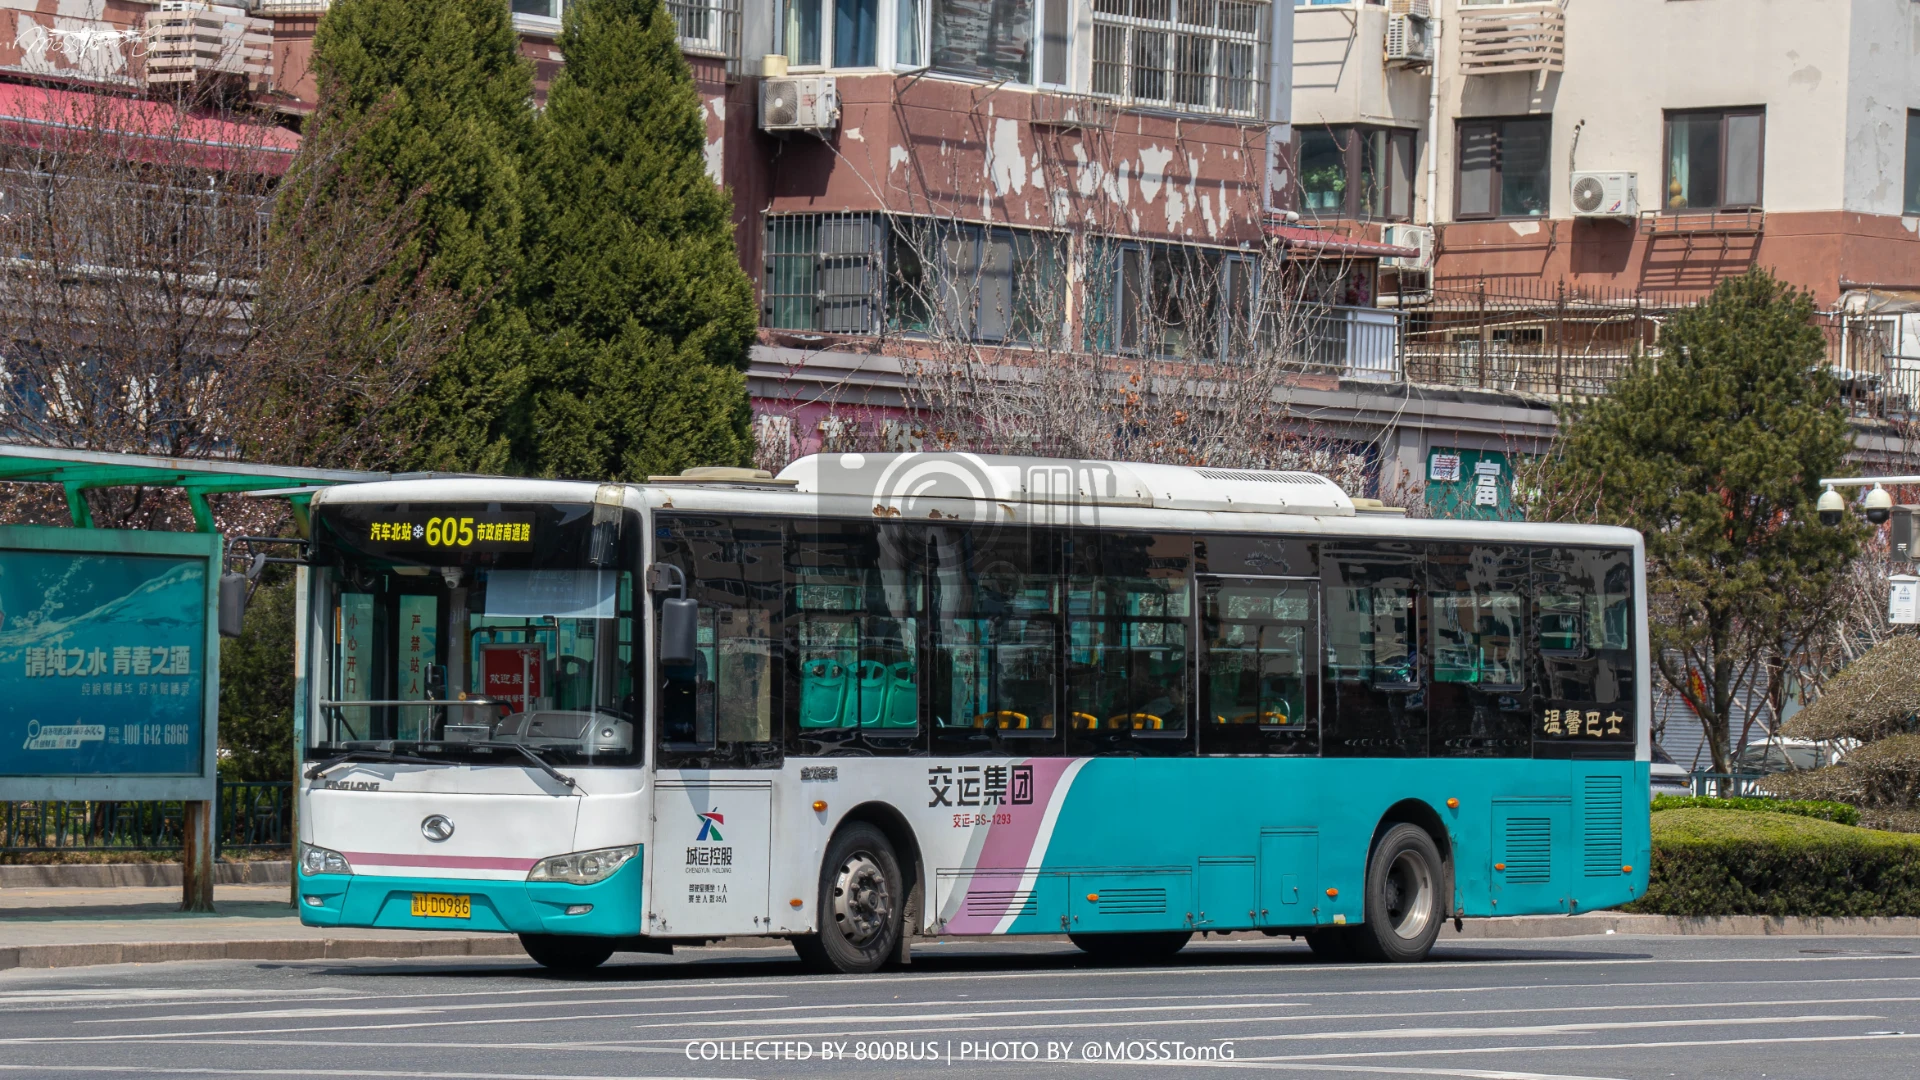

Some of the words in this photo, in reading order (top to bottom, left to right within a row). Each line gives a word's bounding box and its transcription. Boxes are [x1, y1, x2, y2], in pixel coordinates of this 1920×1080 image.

[370, 522, 411, 541] 汽车北站
[425, 517, 474, 546] 605
[477, 522, 531, 542] 市政府南通路
[25, 646, 108, 677] 清纯之水
[113, 645, 191, 675] 青春之酒
[346, 613, 358, 694] 小心开门
[410, 614, 421, 694] 严禁站人
[1543, 708, 1624, 738] 温馨巴士
[325, 780, 350, 790] KING
[350, 781, 381, 791] LONG
[928, 765, 1034, 808] 交运集团
[685, 847, 733, 866] 城运控股
